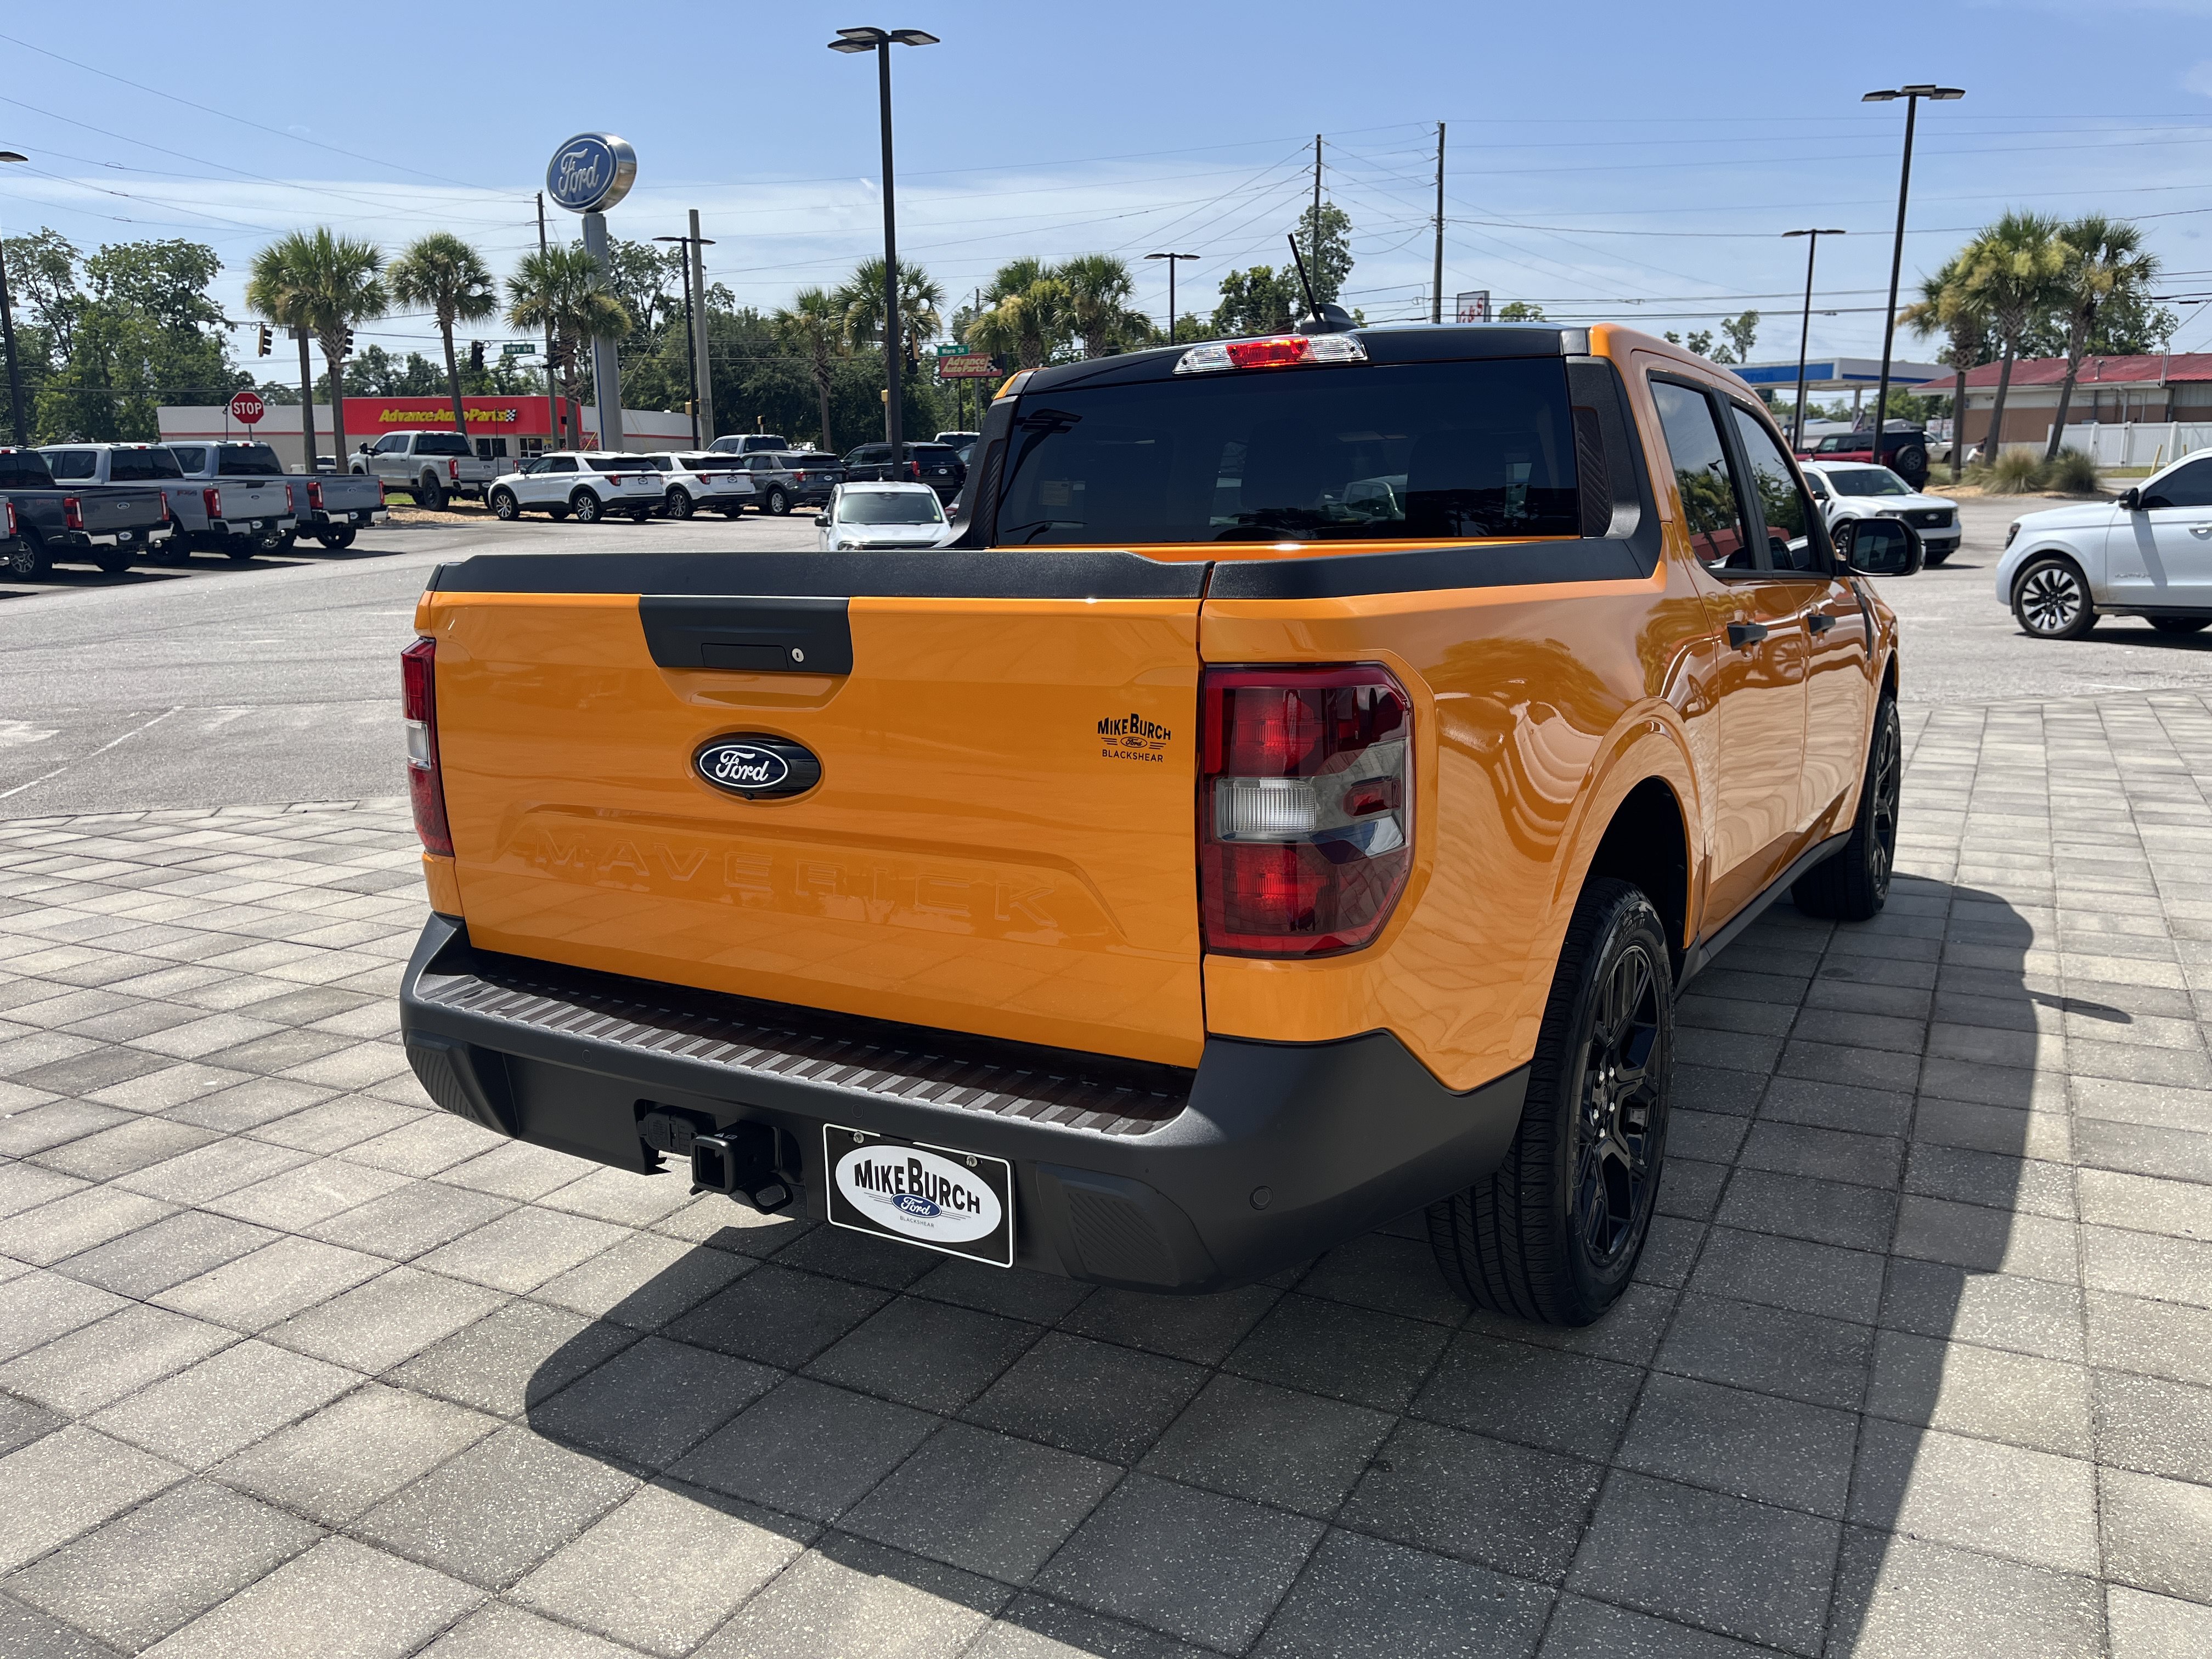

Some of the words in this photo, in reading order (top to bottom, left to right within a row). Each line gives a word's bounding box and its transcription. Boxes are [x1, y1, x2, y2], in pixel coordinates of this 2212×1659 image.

[558, 148, 599, 197] Ford
[947, 357, 985, 366] Advance
[233, 402, 262, 415] STOP
[379, 409, 433, 422] Advance
[434, 408, 469, 421] Auo
[469, 409, 505, 422] Parts
[1126, 737, 1142, 746] Ford
[1102, 749, 1163, 763] BLACKSHEAR
[715, 750, 769, 781] Ford
[536, 829, 1060, 928] MAVERICK
[901, 1197, 931, 1215] Ford
[900, 1216, 934, 1228] BLACKSHEAR
